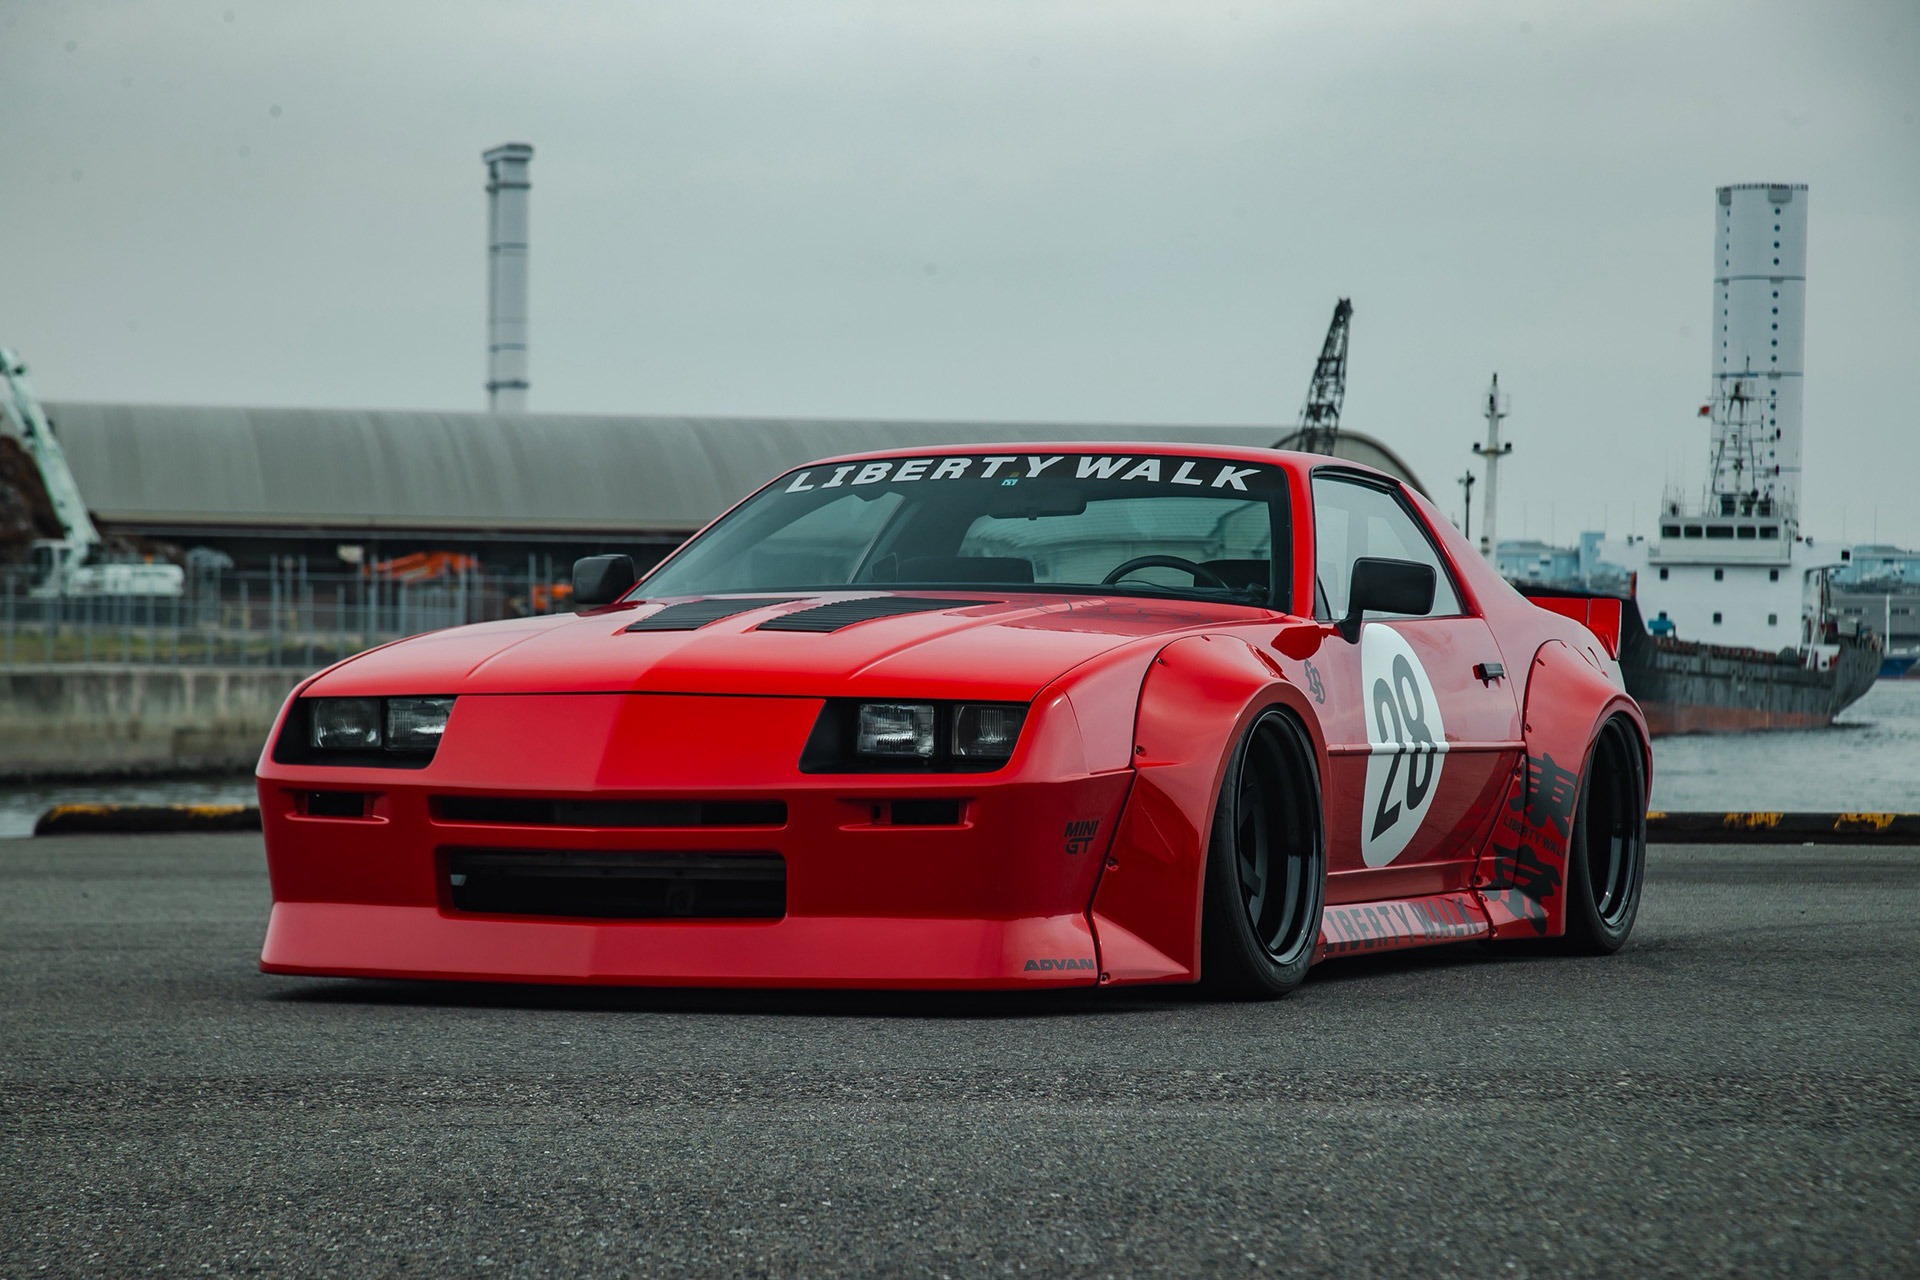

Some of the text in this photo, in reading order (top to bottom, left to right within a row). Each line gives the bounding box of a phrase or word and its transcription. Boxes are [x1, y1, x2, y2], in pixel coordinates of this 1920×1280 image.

[784, 456, 1261, 494] LIBERTY WALK
[1370, 654, 1433, 842] 28
[1064, 820, 1099, 837] MINI
[1066, 837, 1094, 855] GT
[1408, 897, 1479, 940] WALK
[1024, 959, 1095, 971] ADVAN
